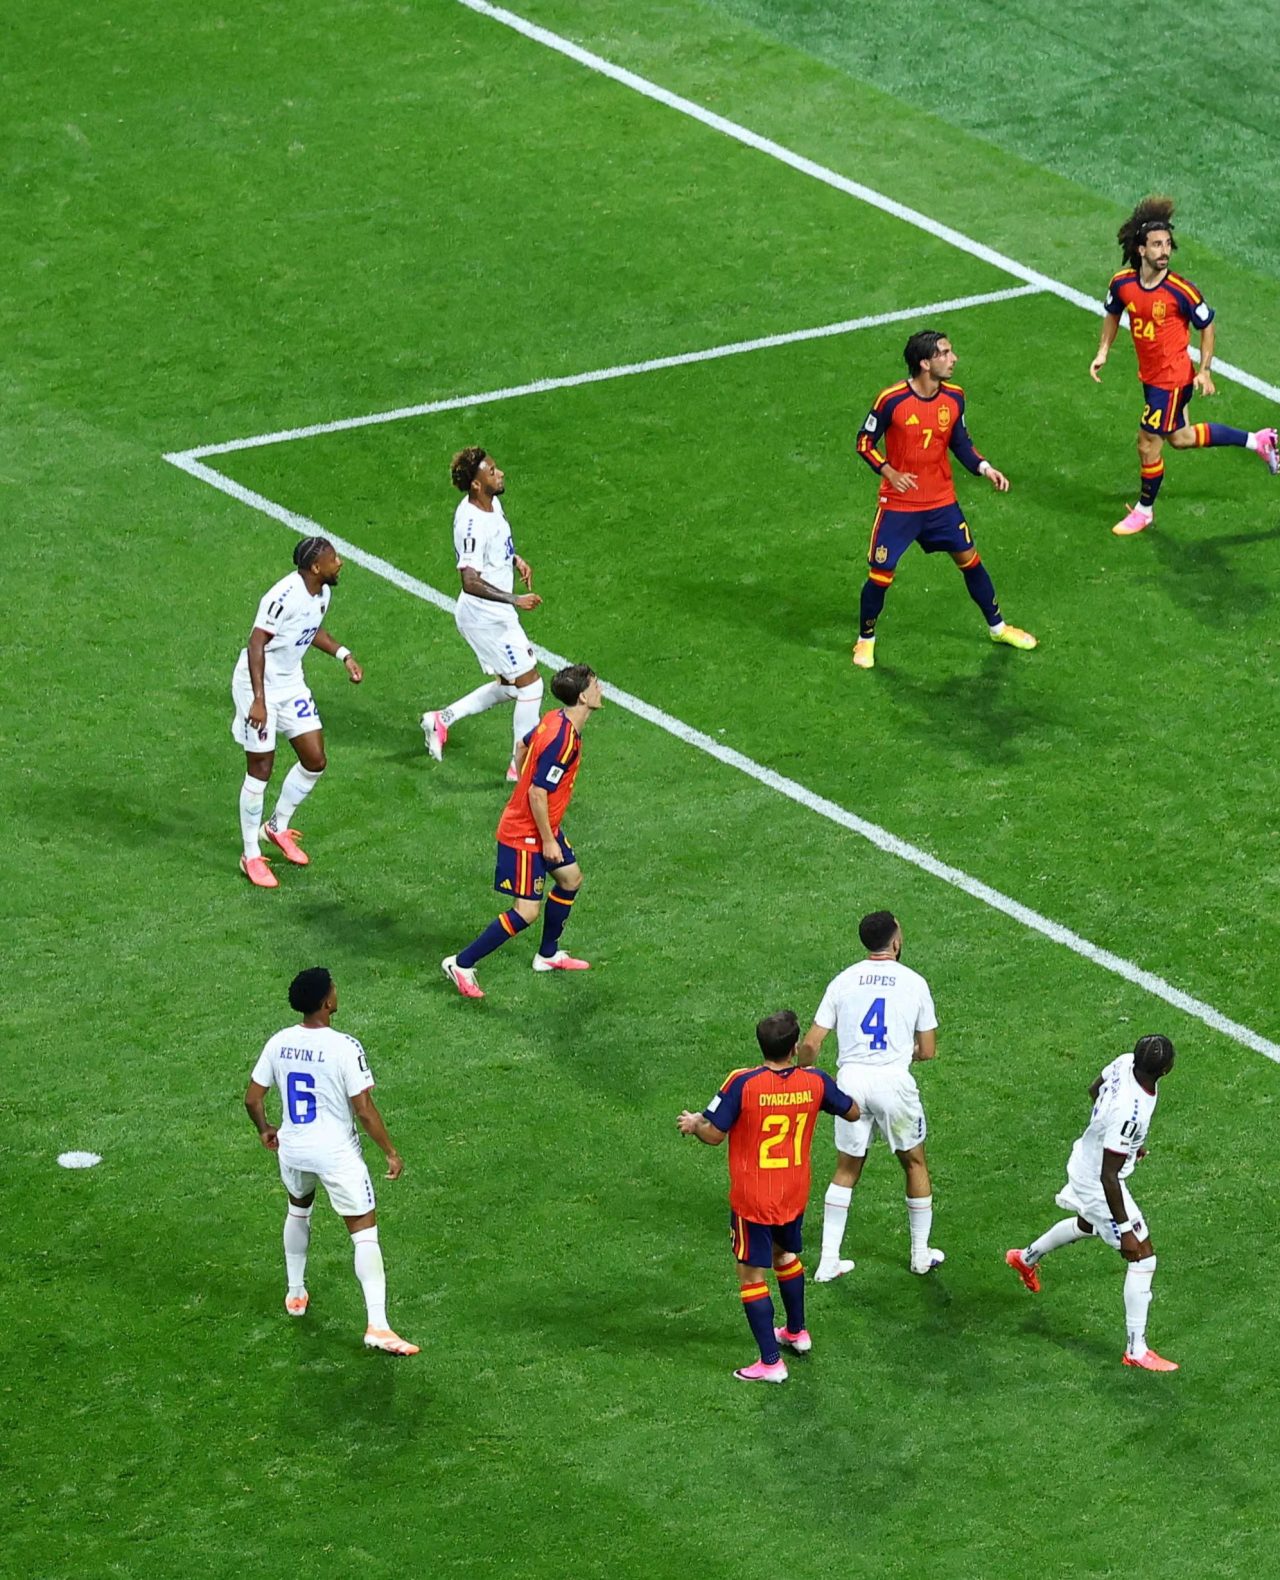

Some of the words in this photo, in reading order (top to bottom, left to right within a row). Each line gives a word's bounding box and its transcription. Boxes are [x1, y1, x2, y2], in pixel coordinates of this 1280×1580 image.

[1133, 318, 1155, 342] 24
[1141, 405, 1162, 430] 24
[922, 429, 933, 450] 7
[959, 522, 971, 544] 7
[859, 974, 896, 987] LOPES
[860, 997, 888, 1051] 4
[318, 1051, 325, 1063] L
[287, 1071, 317, 1125] 6
[759, 1089, 814, 1107] OYARZABAL
[758, 1112, 809, 1169] 21
